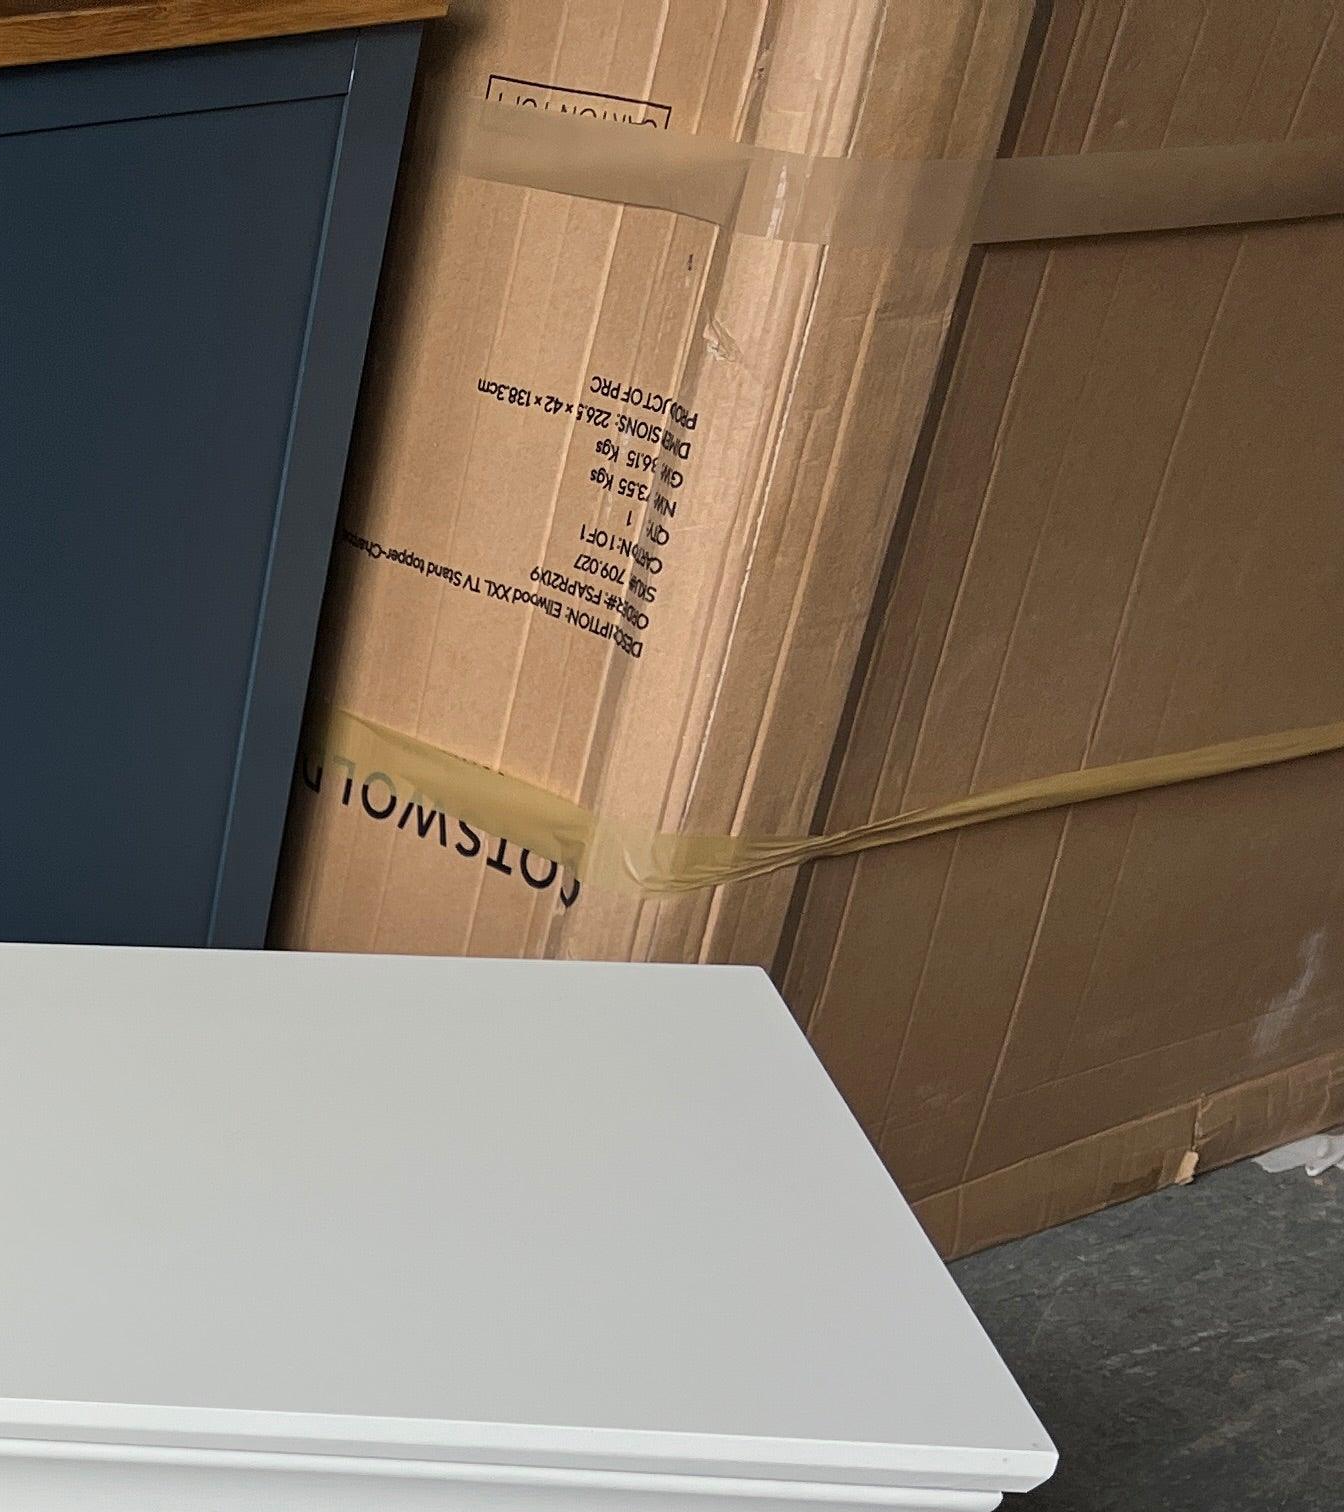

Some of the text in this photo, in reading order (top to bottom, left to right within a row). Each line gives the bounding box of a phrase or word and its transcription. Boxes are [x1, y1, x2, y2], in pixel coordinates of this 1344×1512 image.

[477, 377, 532, 408] 138.3cm
[590, 375, 621, 400] PRC
[621, 385, 643, 407] OF
[544, 394, 563, 415] 42
[575, 403, 612, 429] 226.5
[595, 438, 620, 463] Kgs
[589, 466, 613, 492] Kgs
[626, 509, 633, 527] 1
[425, 560, 463, 587] Stand
[573, 553, 626, 585] 709.027
[462, 573, 482, 594] TV
[484, 578, 512, 603] XXL
[512, 587, 563, 619] Ellwood
